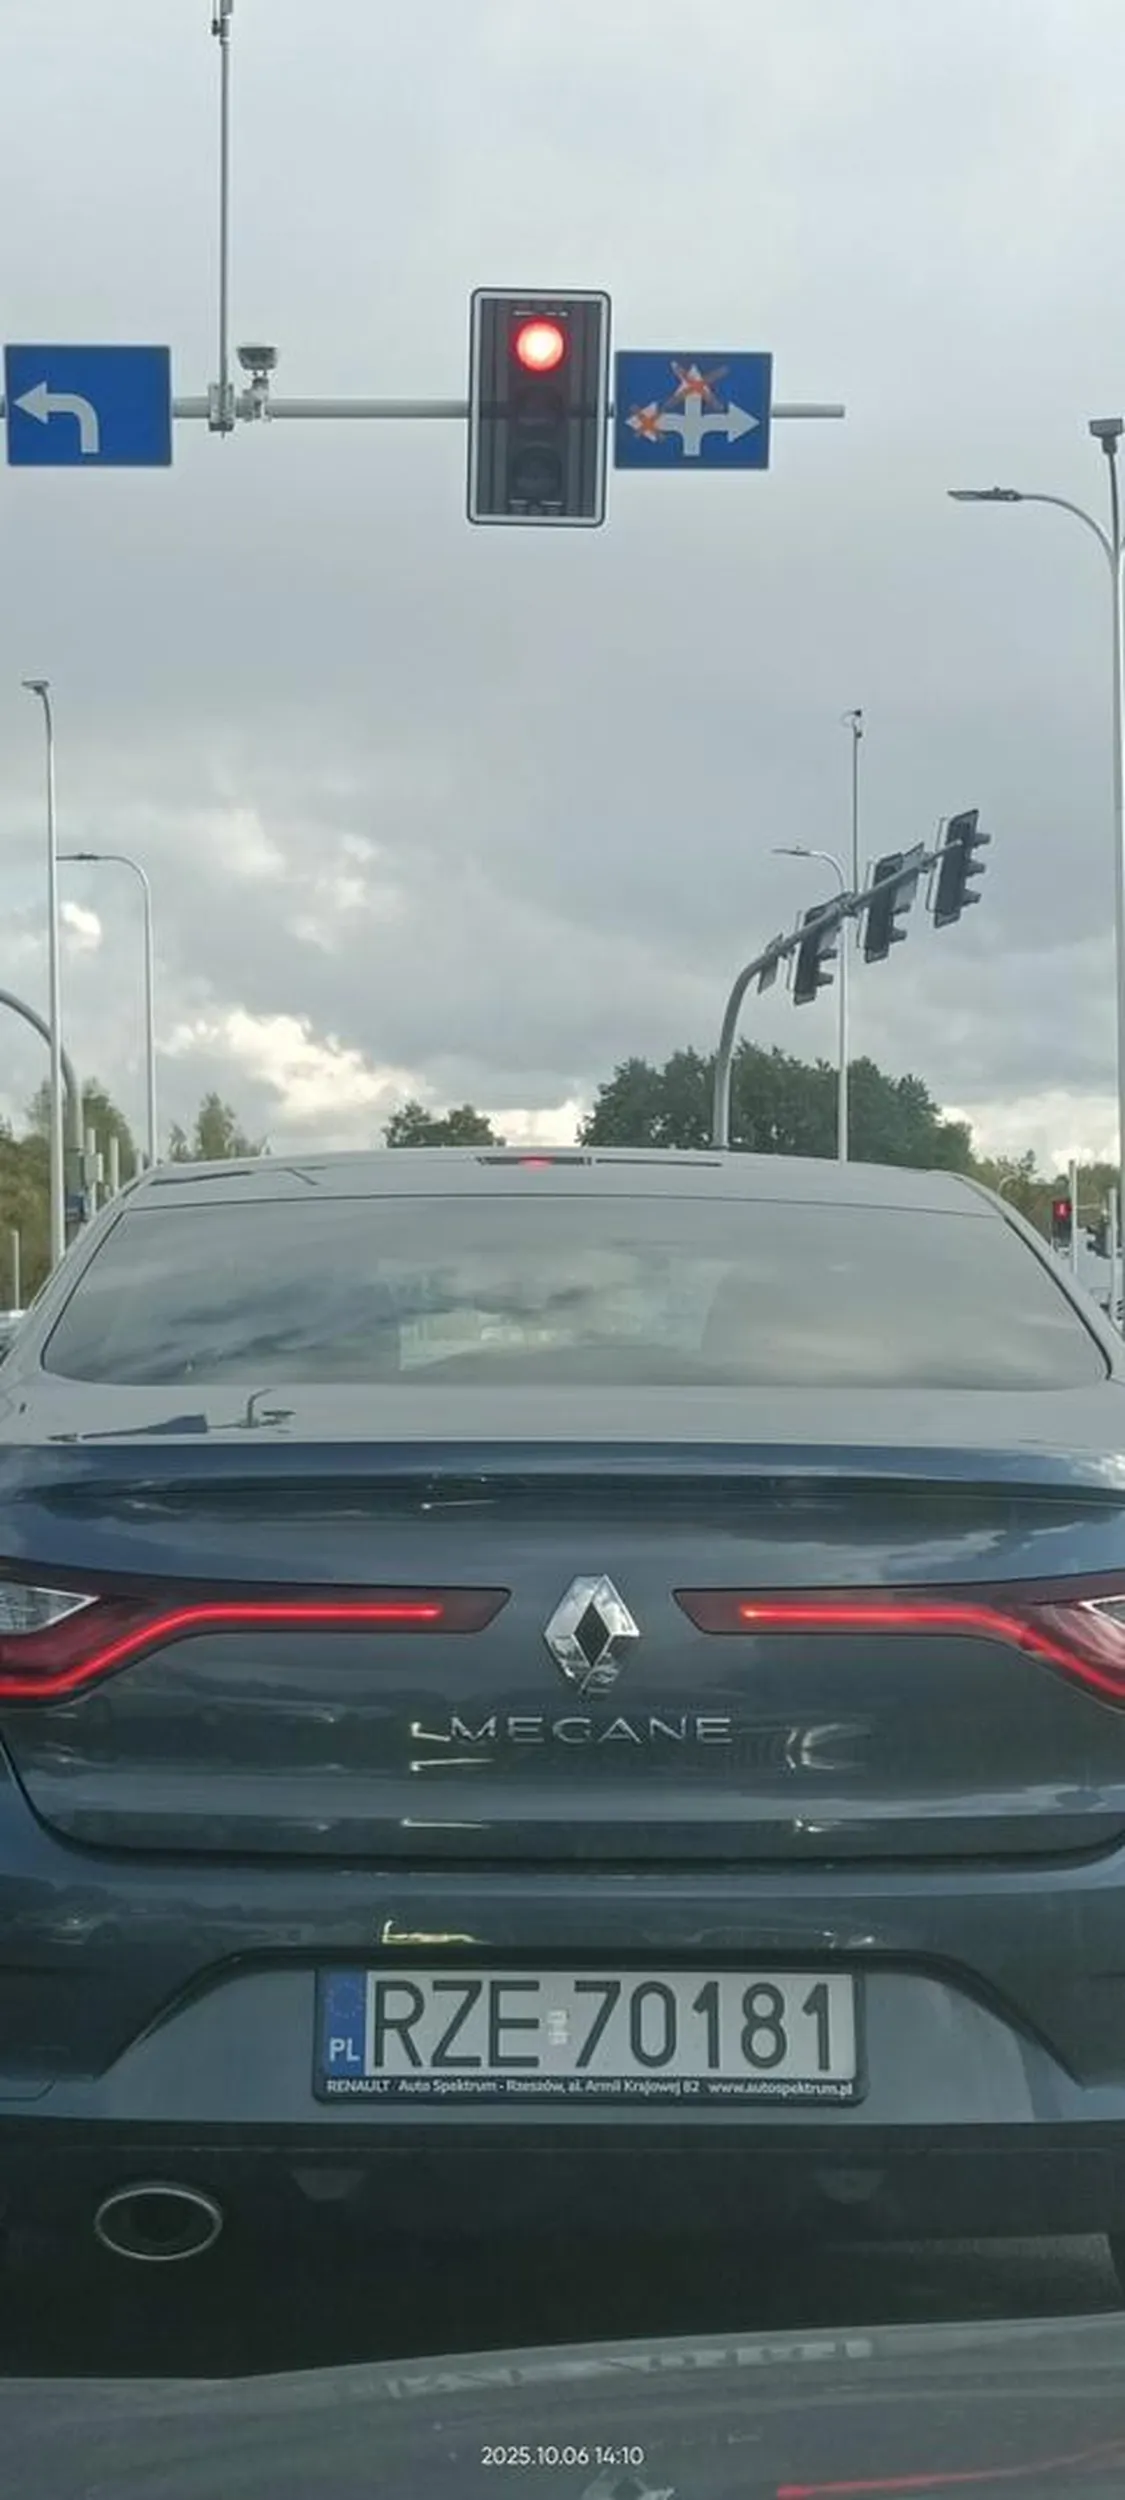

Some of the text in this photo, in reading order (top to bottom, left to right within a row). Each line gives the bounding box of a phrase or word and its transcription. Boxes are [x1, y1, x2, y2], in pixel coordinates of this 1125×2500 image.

[450, 1716, 733, 1744] MEGANE
[374, 1980, 831, 2071] RZE 70181
[328, 2037, 360, 2062] PL
[326, 2079, 390, 2093] RENAULT
[399, 2079, 430, 2092] Auto
[433, 2079, 496, 2094] Spektrum
[708, 2081, 853, 2098] www.autospektrum.pl
